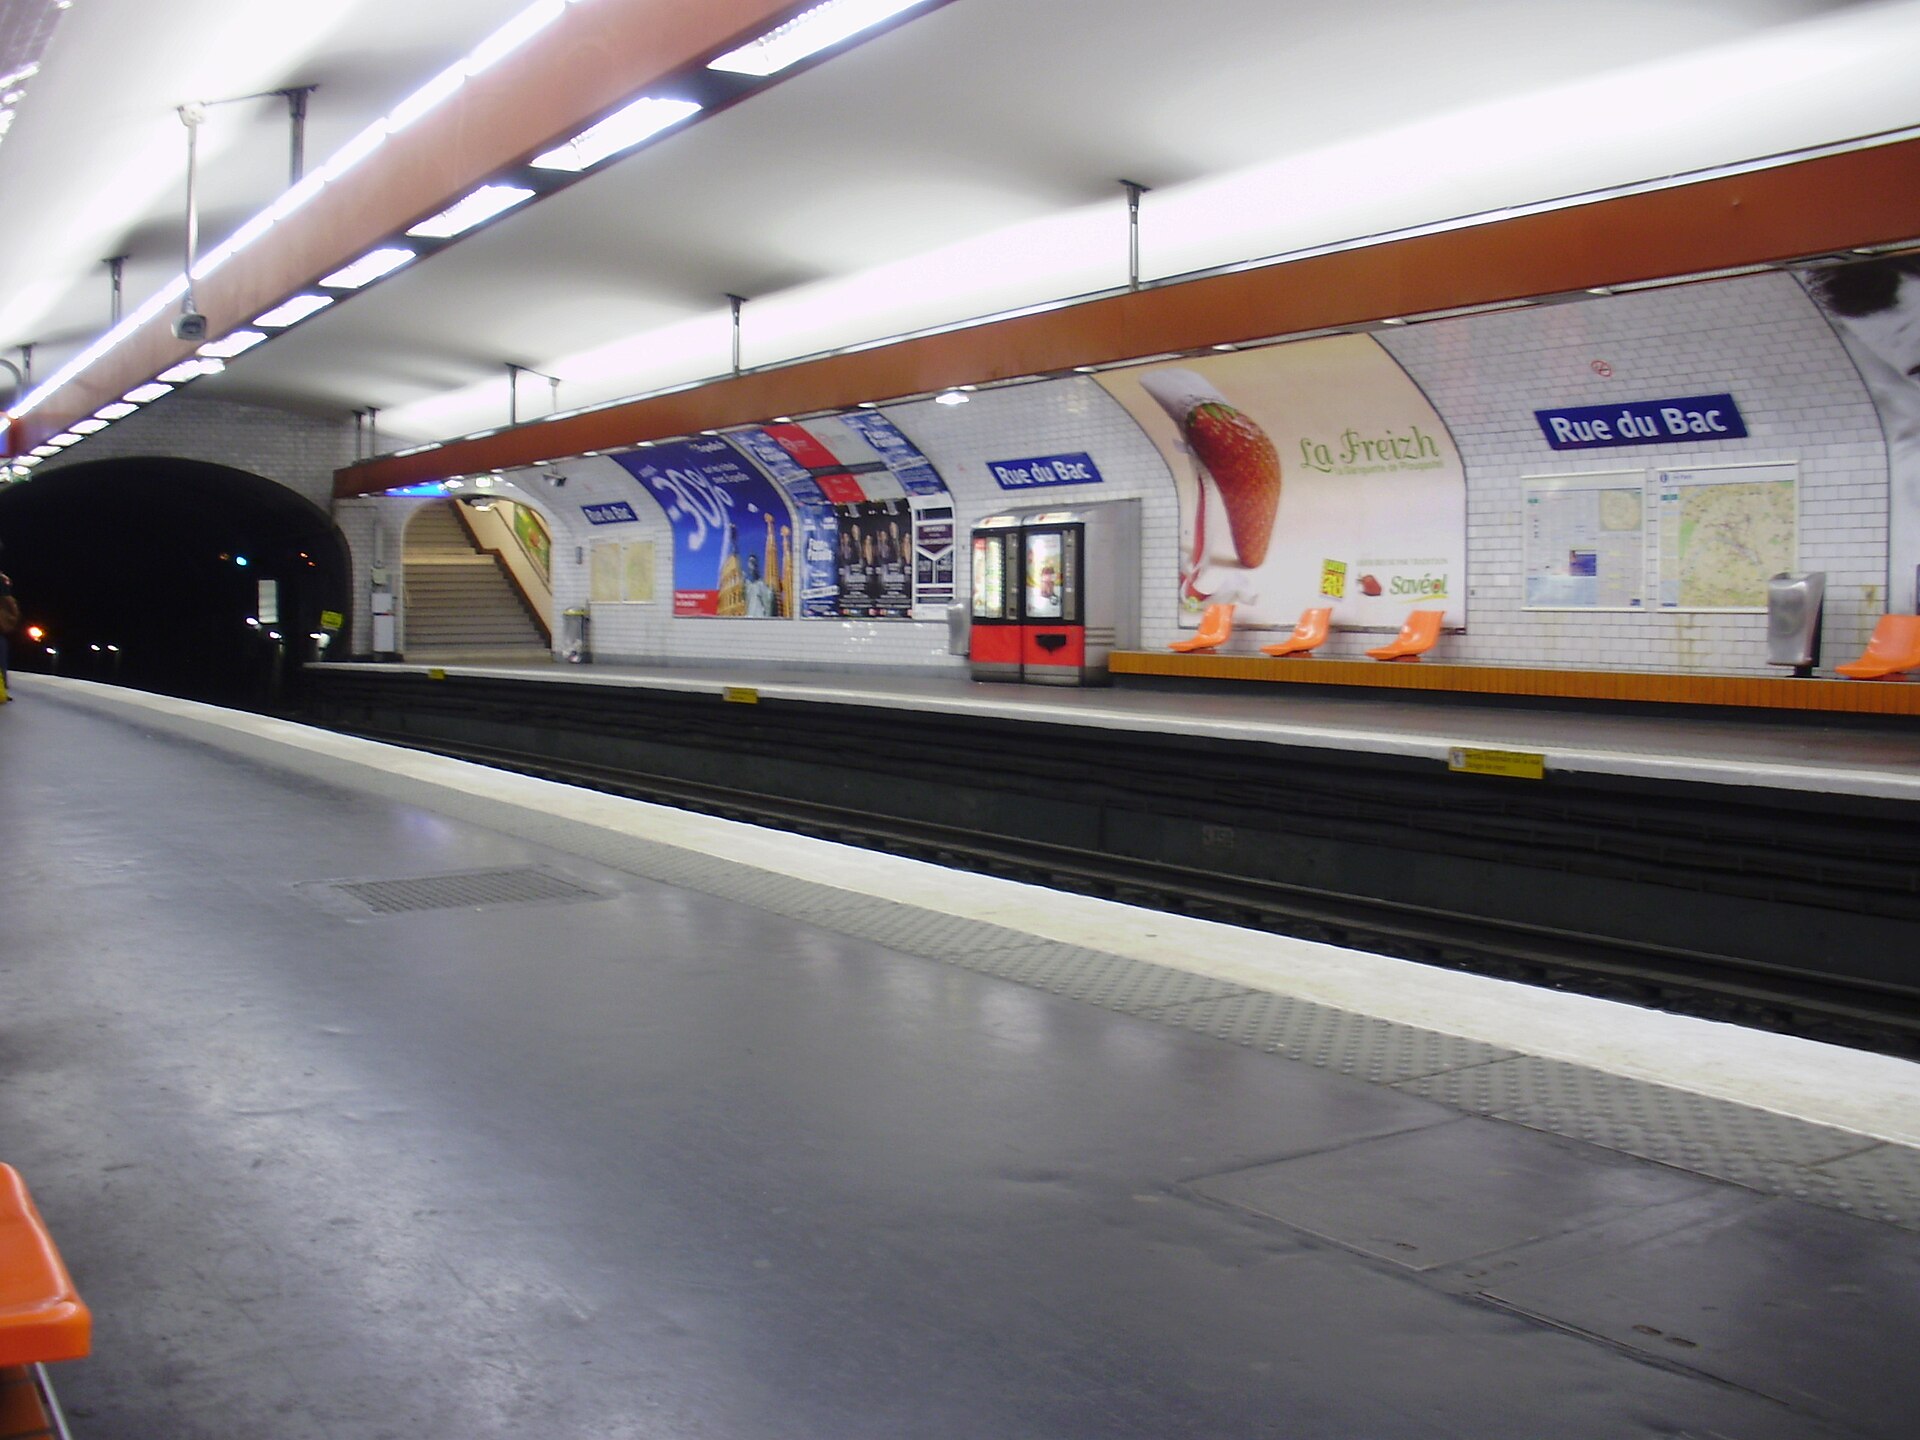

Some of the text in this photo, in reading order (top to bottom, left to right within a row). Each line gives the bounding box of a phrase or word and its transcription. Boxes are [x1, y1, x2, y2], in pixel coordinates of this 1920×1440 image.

[1549, 407, 1728, 443] Rue du Bac
[1339, 425, 1439, 464] Freizh
[994, 460, 1092, 485] Rue du Bac
[1389, 572, 1449, 595] Savéol
